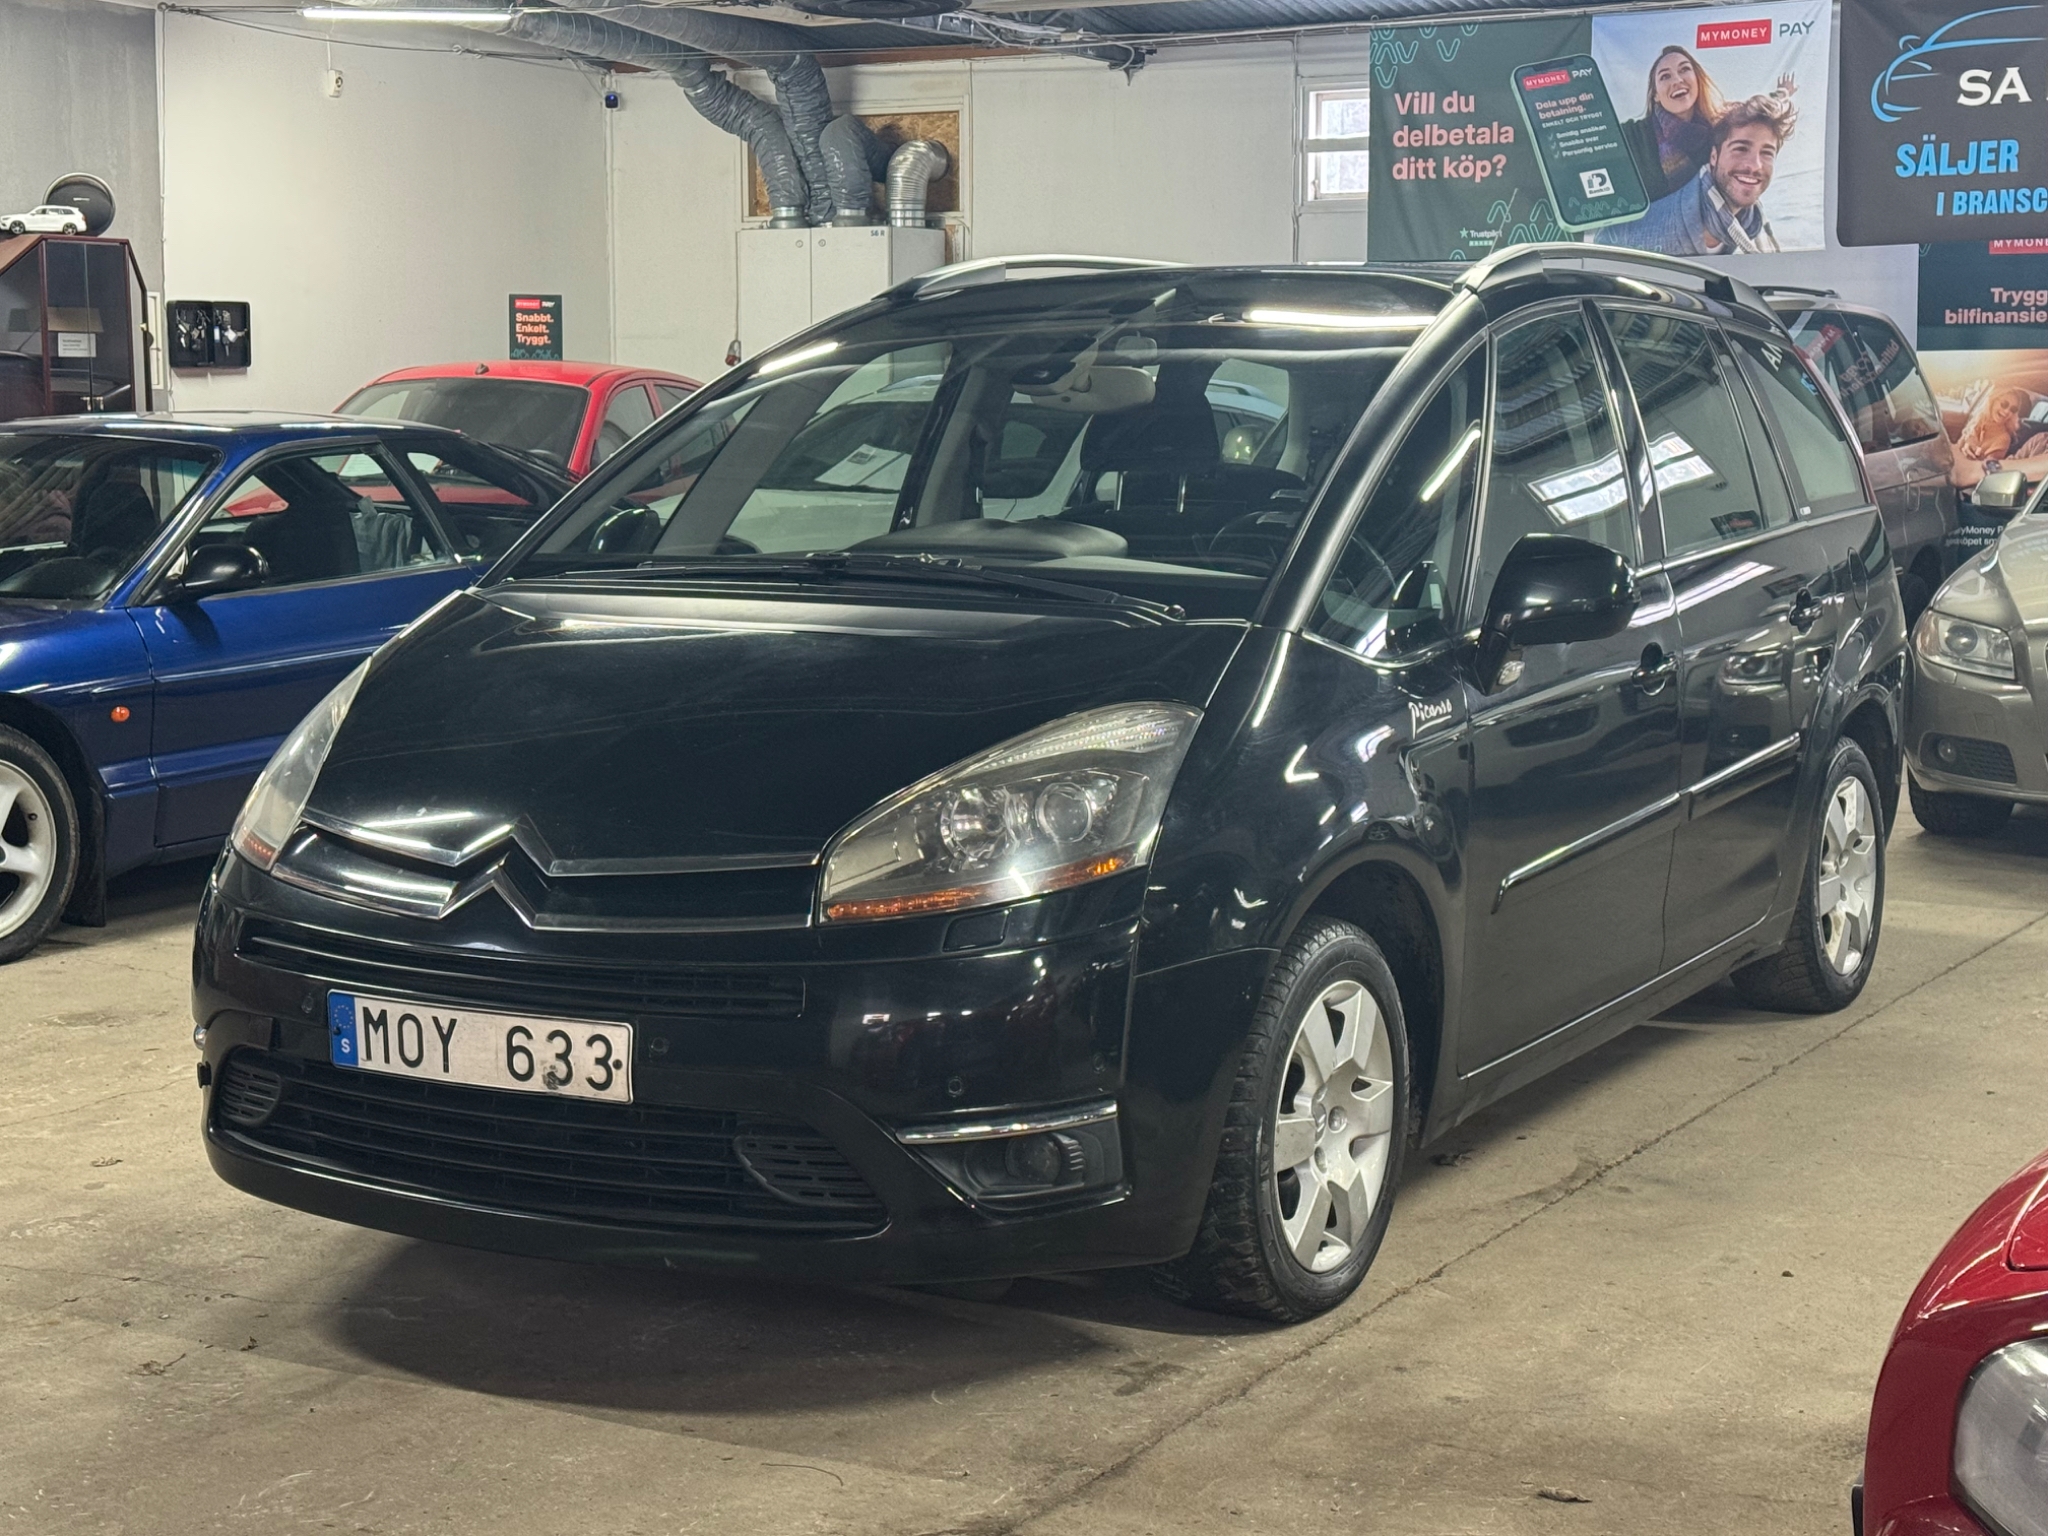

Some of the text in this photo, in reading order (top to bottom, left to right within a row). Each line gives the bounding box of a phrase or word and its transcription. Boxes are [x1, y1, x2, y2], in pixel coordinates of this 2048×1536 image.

[1700, 20, 1815, 43] MYMONEY PAY
[1526, 67, 1593, 86] MYMONEY PAY
[1956, 66, 2033, 107] SA
[1394, 91, 1475, 116] Vill du
[1535, 92, 1595, 110] Dela upp din
[1539, 105, 1586, 119] betalning.
[1392, 122, 1515, 148] delbetala
[1895, 134, 2020, 178] SÄLJER
[1392, 153, 1507, 184] ditt köp?
[1936, 187, 2048, 216] I BRANSC
[1990, 287, 2048, 307] Trygg
[515, 312, 554, 323] Snabbt.
[1944, 306, 2048, 325] bilfinansie
[515, 323, 550, 333] Enkelt.
[515, 334, 551, 346] Tryggt.
[1960, 525, 1996, 536] yMoney
[340, 1038, 351, 1053] S
[362, 1006, 614, 1092] MOY 633
